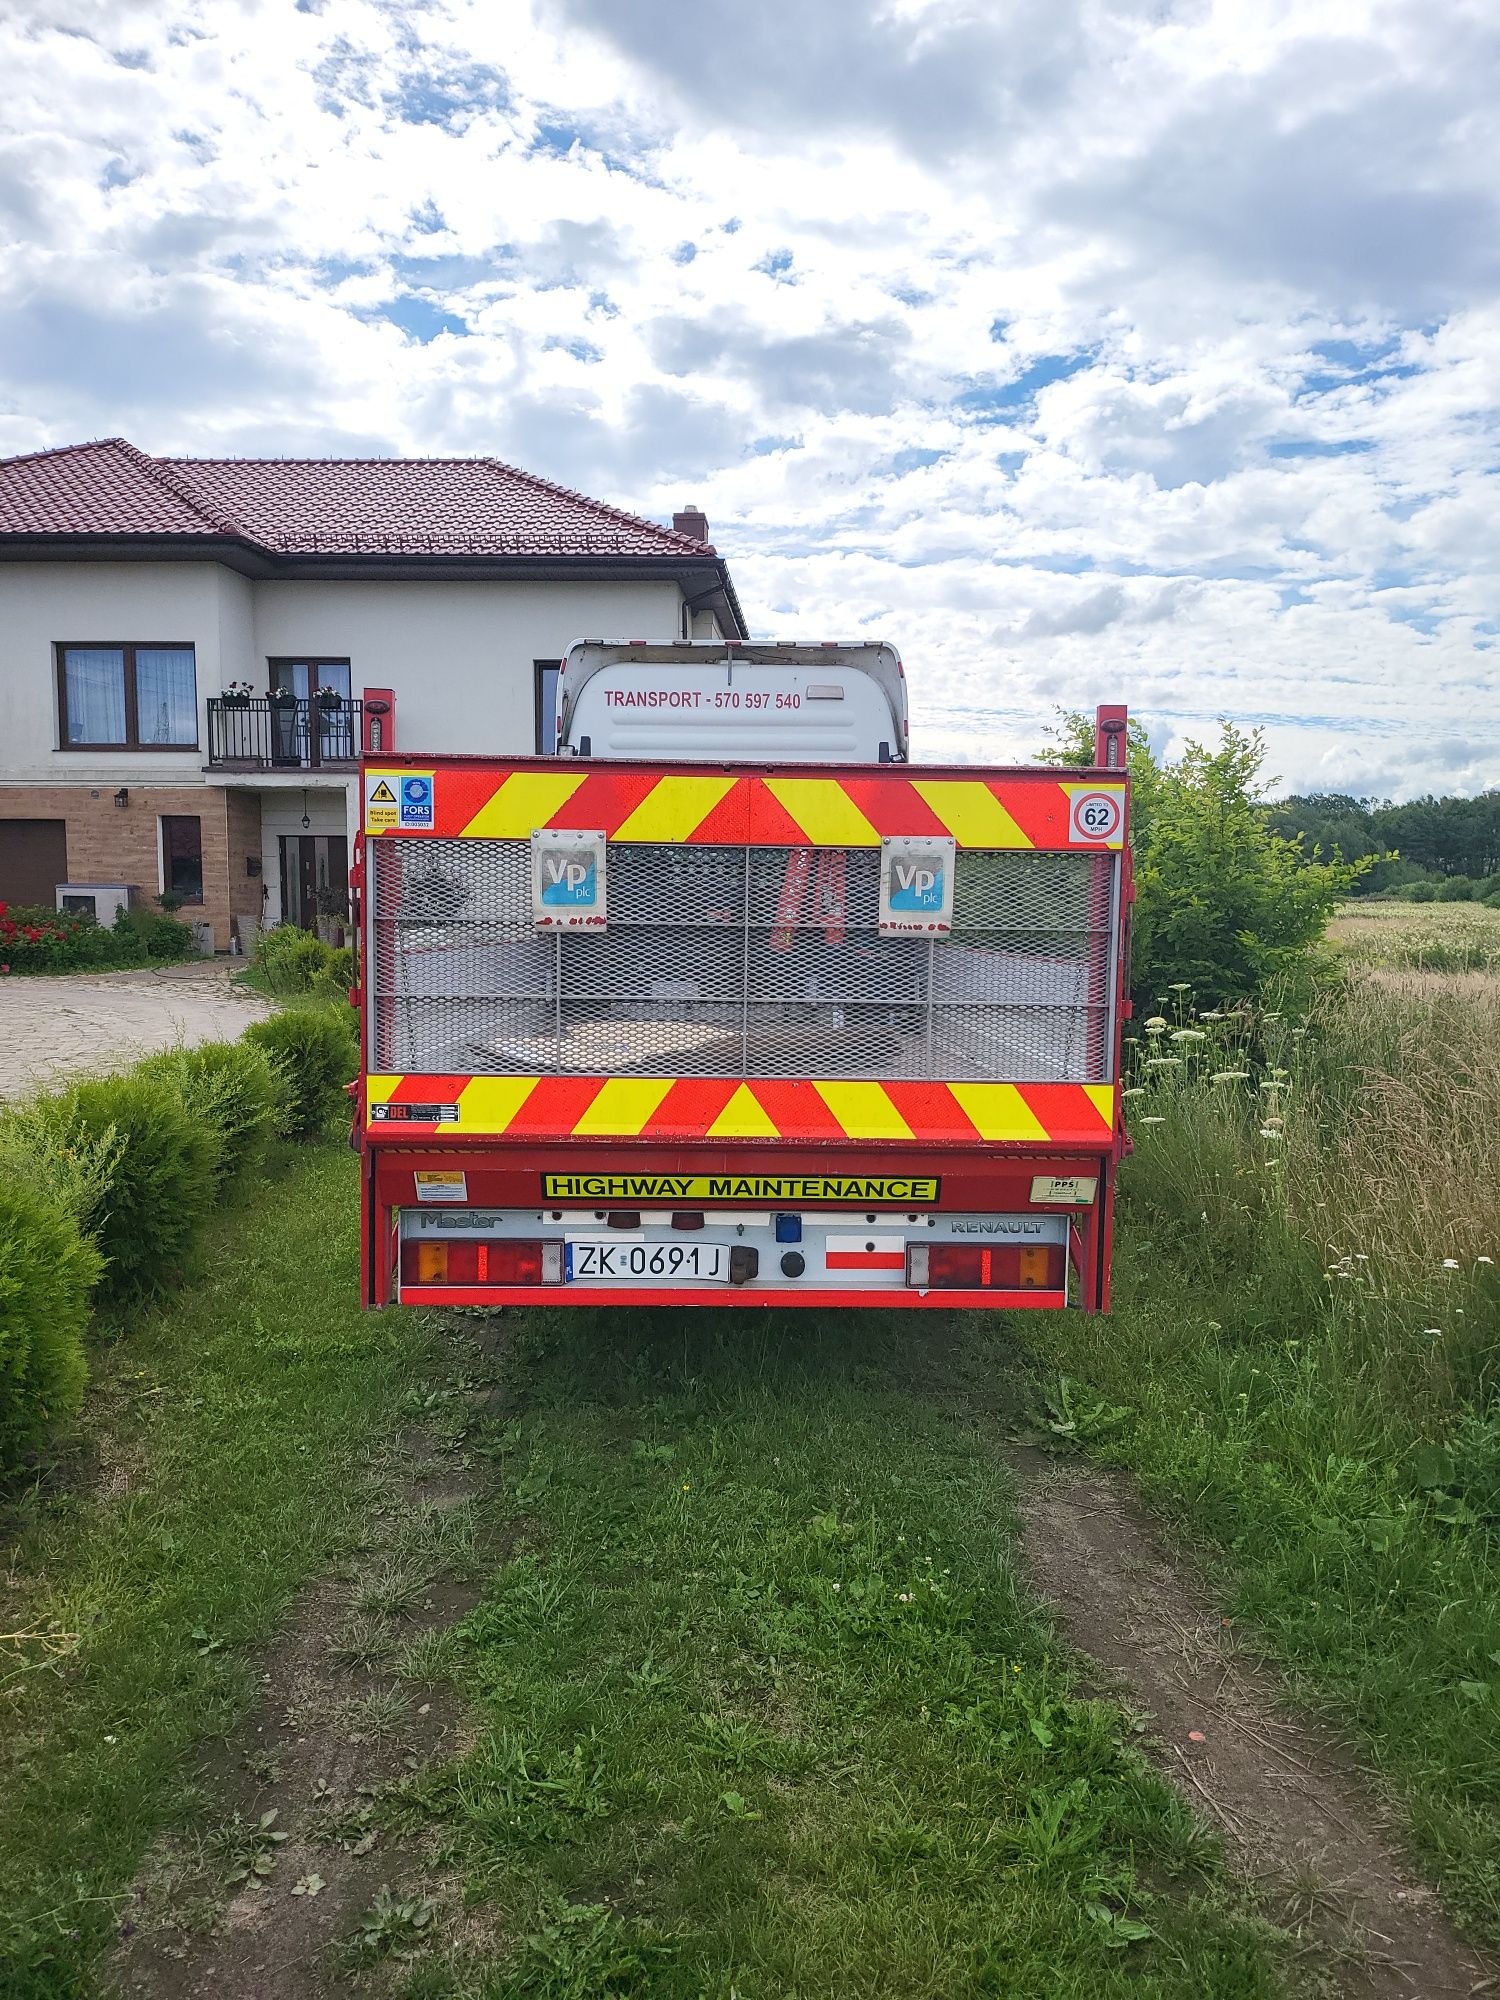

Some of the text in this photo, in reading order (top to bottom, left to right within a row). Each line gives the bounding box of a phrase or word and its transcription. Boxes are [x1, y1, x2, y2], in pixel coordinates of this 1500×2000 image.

[604, 691, 702, 708] TRANSPORT
[714, 692, 740, 708] 570
[745, 693, 771, 709] 597
[775, 693, 801, 709] 540
[403, 806, 430, 815] FORS
[1085, 808, 1109, 826] 62
[546, 859, 587, 892] Vp
[895, 865, 935, 897] Vp
[576, 886, 591, 899] plc
[923, 893, 938, 905] plc
[390, 1106, 408, 1119] DEL
[552, 1178, 930, 1198] HIGHWAY MAINTENANCE
[420, 1211, 503, 1229] Master
[951, 1220, 1045, 1234] RENAULT
[578, 1246, 720, 1277] ZK 0691J
